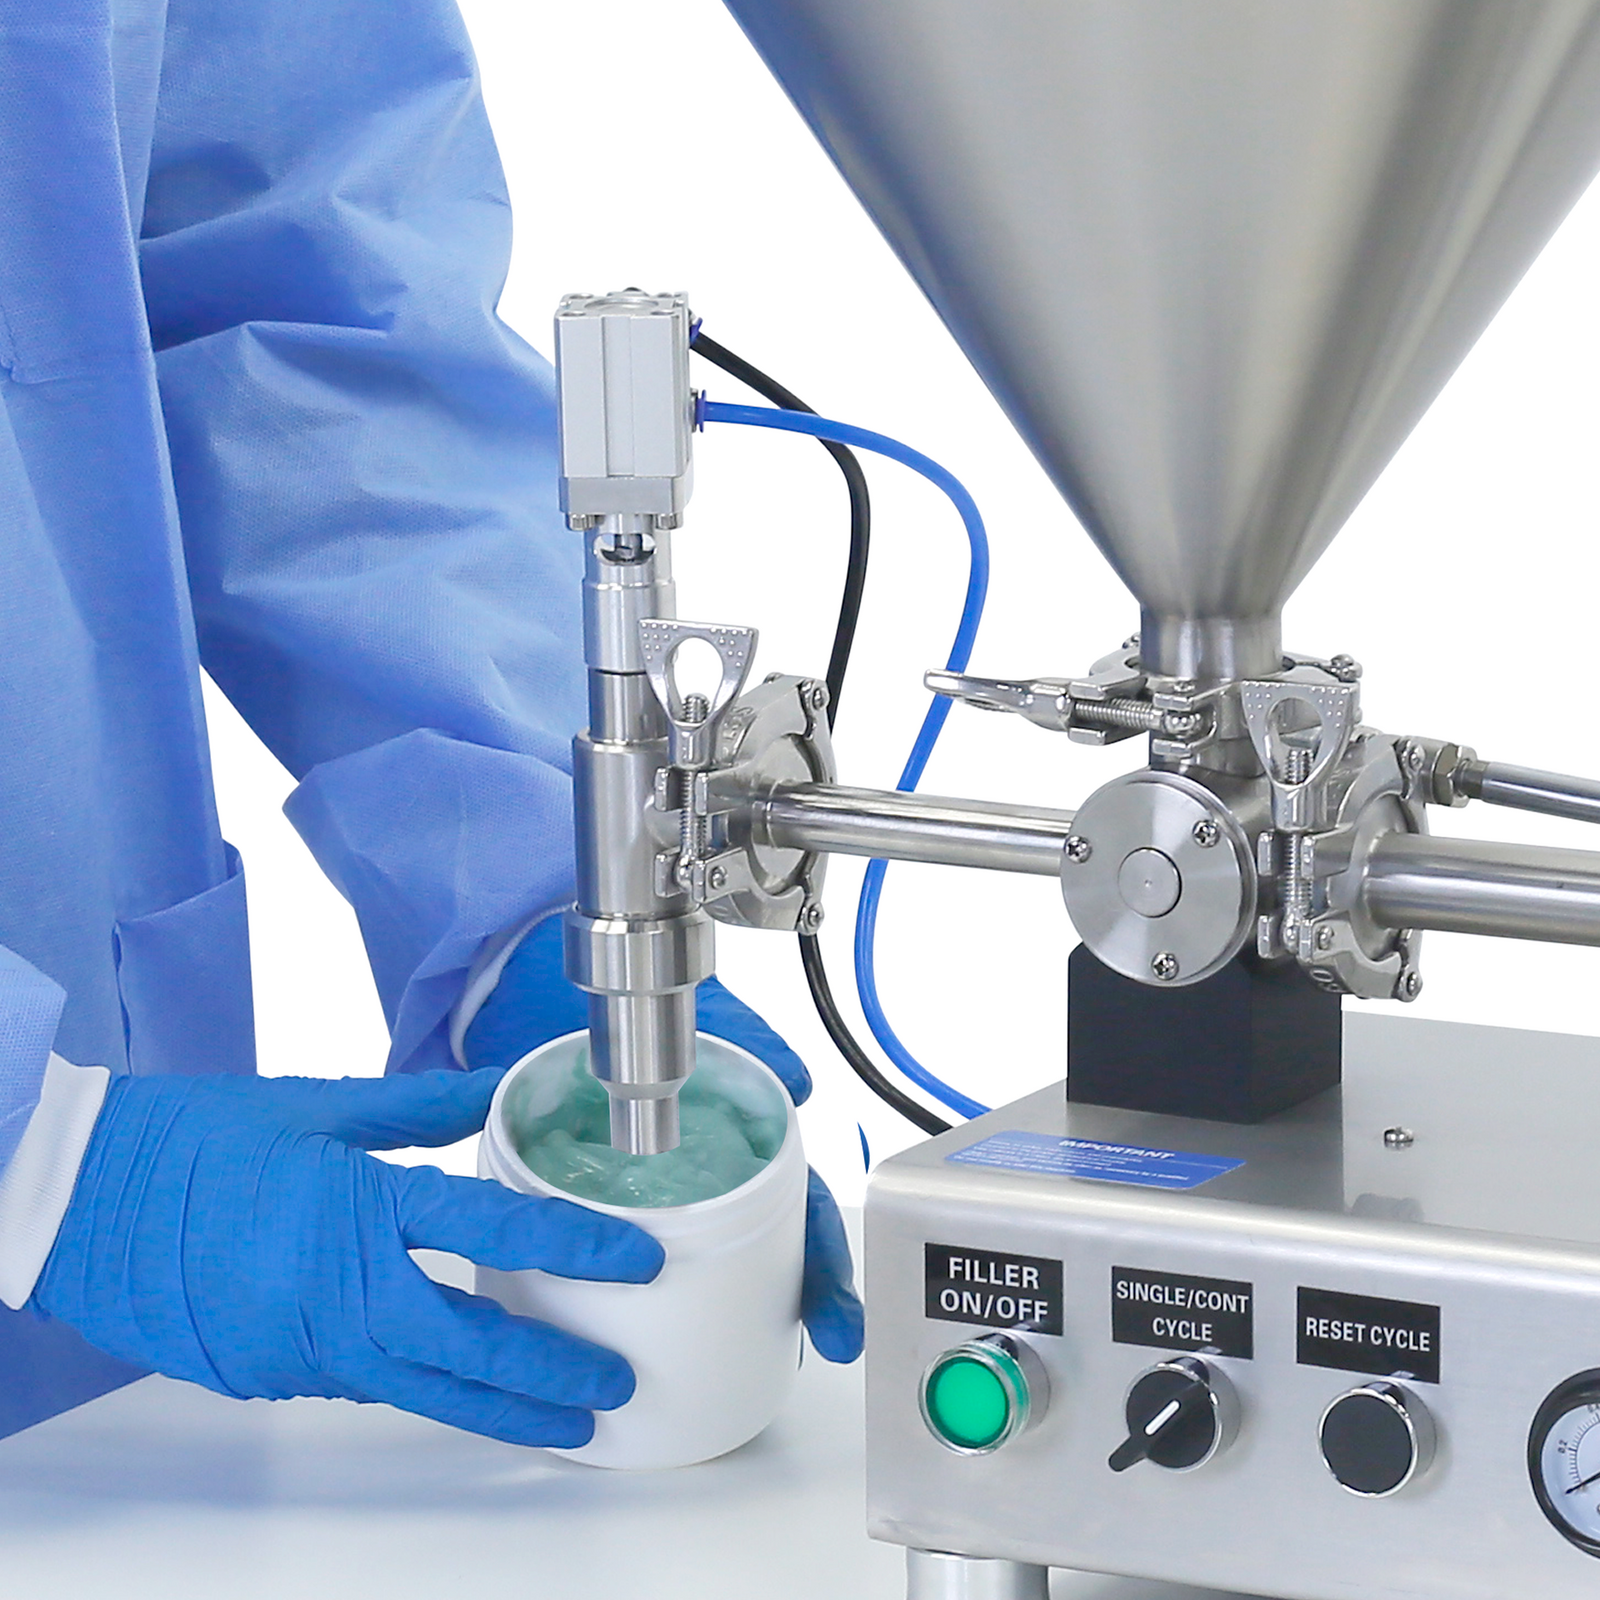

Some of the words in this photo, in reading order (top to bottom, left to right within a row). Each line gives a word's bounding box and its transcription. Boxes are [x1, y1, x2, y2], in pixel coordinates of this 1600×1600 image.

[1058, 1139, 1175, 1160] IMPORTANT
[948, 1256, 1040, 1290] FILLER
[940, 1288, 1049, 1325] ON/OFF
[1116, 1280, 1250, 1314] SINGLE/CONT
[1152, 1317, 1213, 1343] CYCLE
[1306, 1316, 1367, 1344] RESET
[1370, 1325, 1431, 1353] CYCLE
